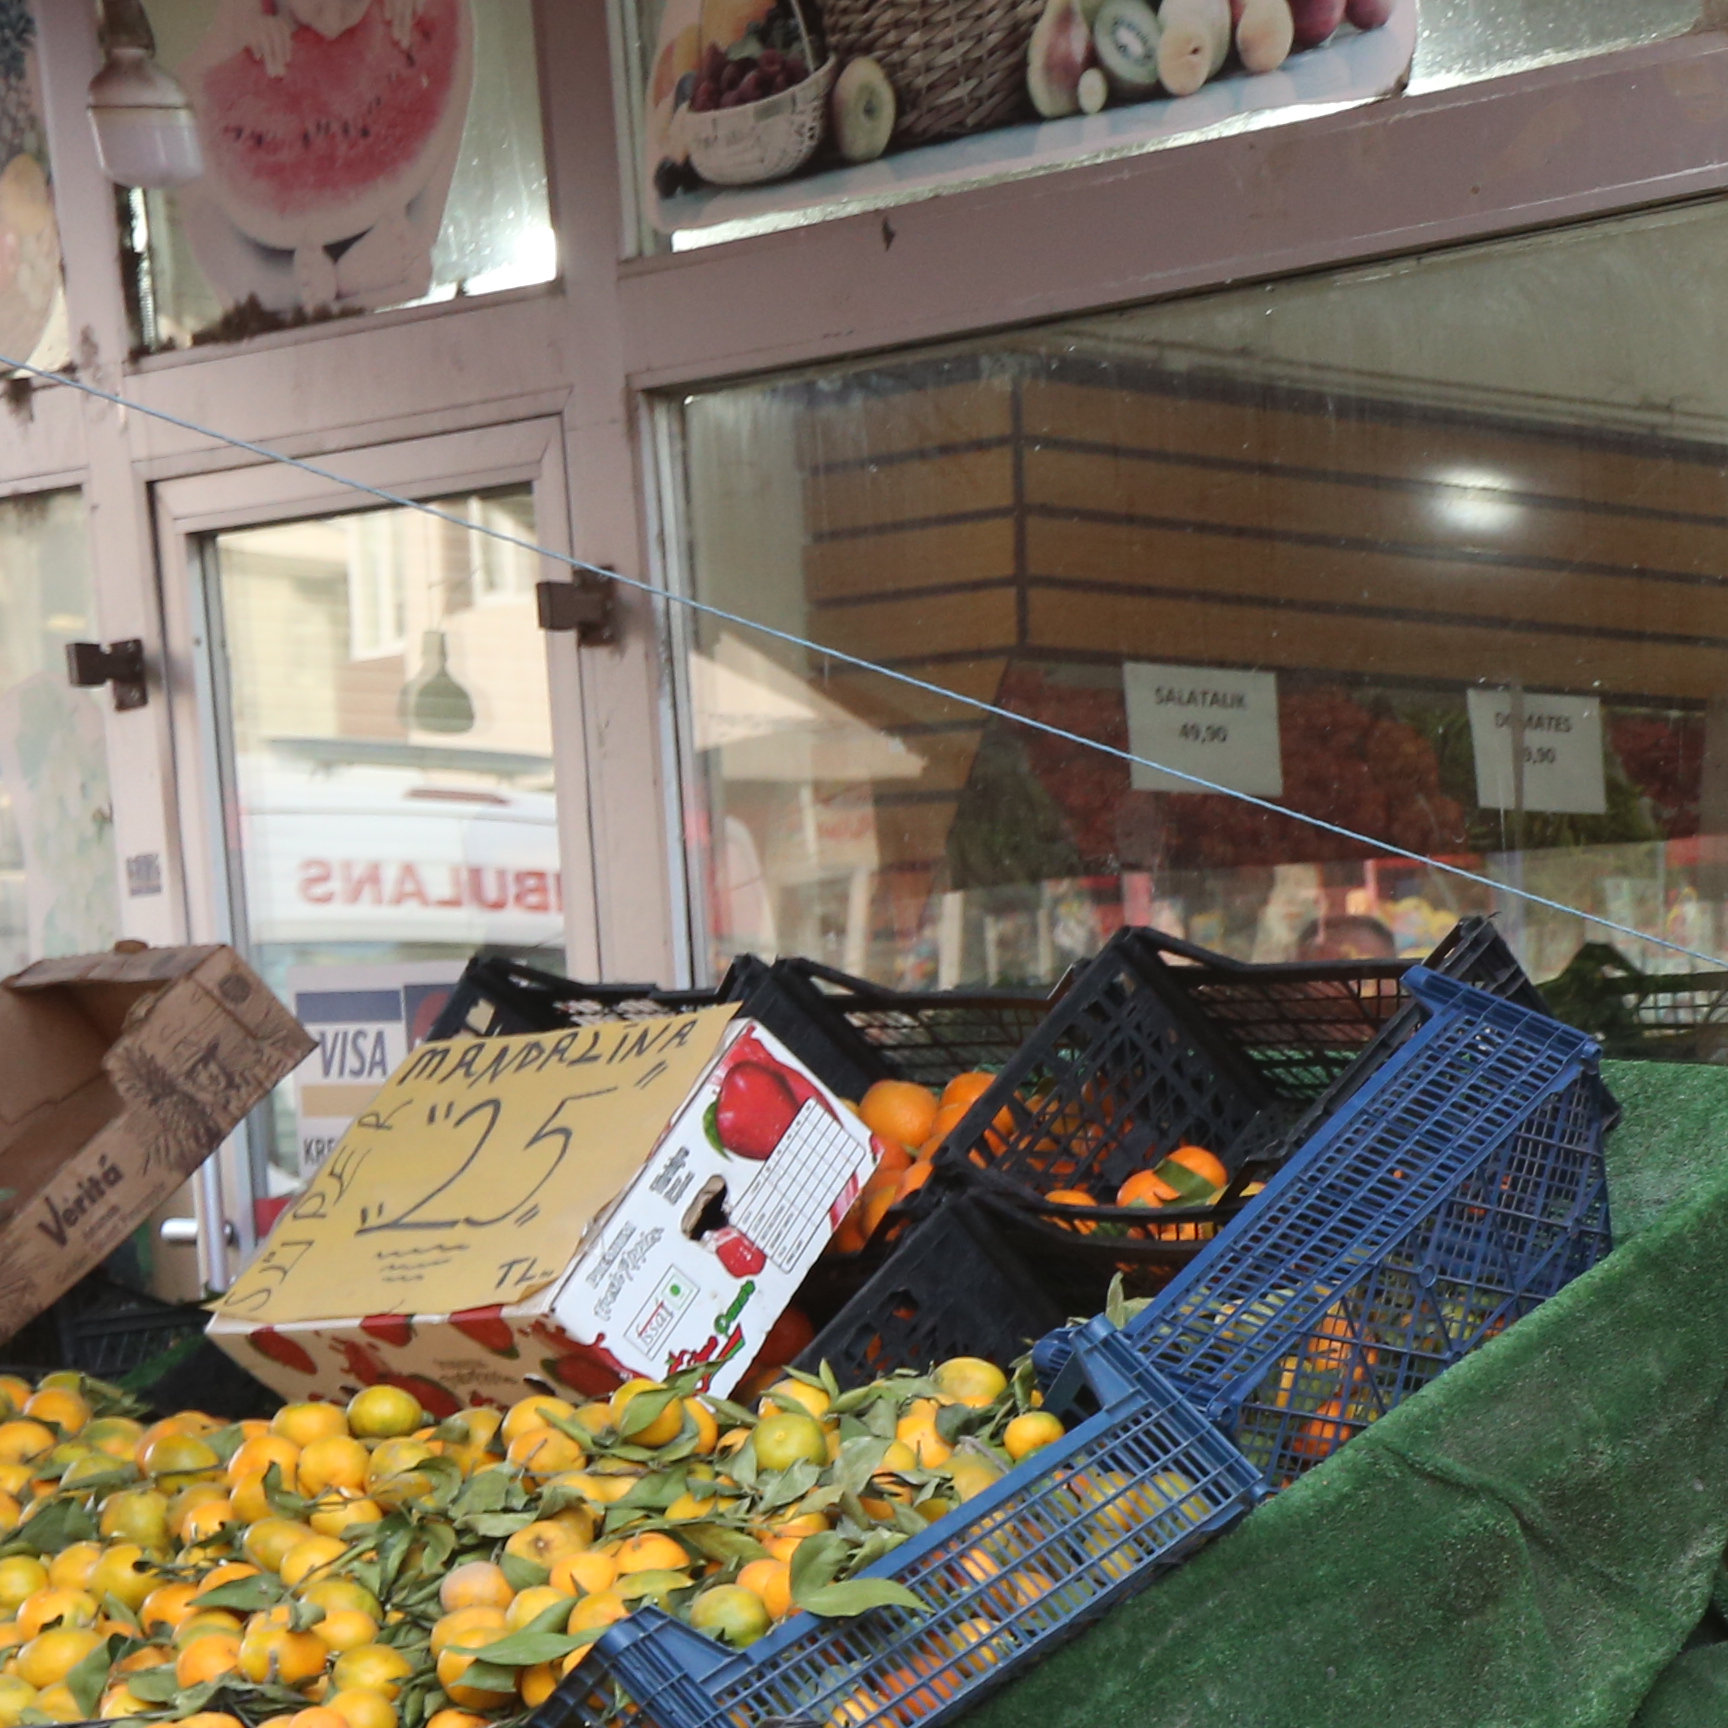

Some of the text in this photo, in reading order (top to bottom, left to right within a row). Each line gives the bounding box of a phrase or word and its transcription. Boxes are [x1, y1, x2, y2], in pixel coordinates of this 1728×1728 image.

[1155, 686, 1246, 711] SALATALIK
[318, 1030, 388, 1080] VISA
[397, 1017, 696, 1086] MANDALİNA
[356, 1087, 618, 1237] 25
[224, 1099, 414, 1313] SÜPER
